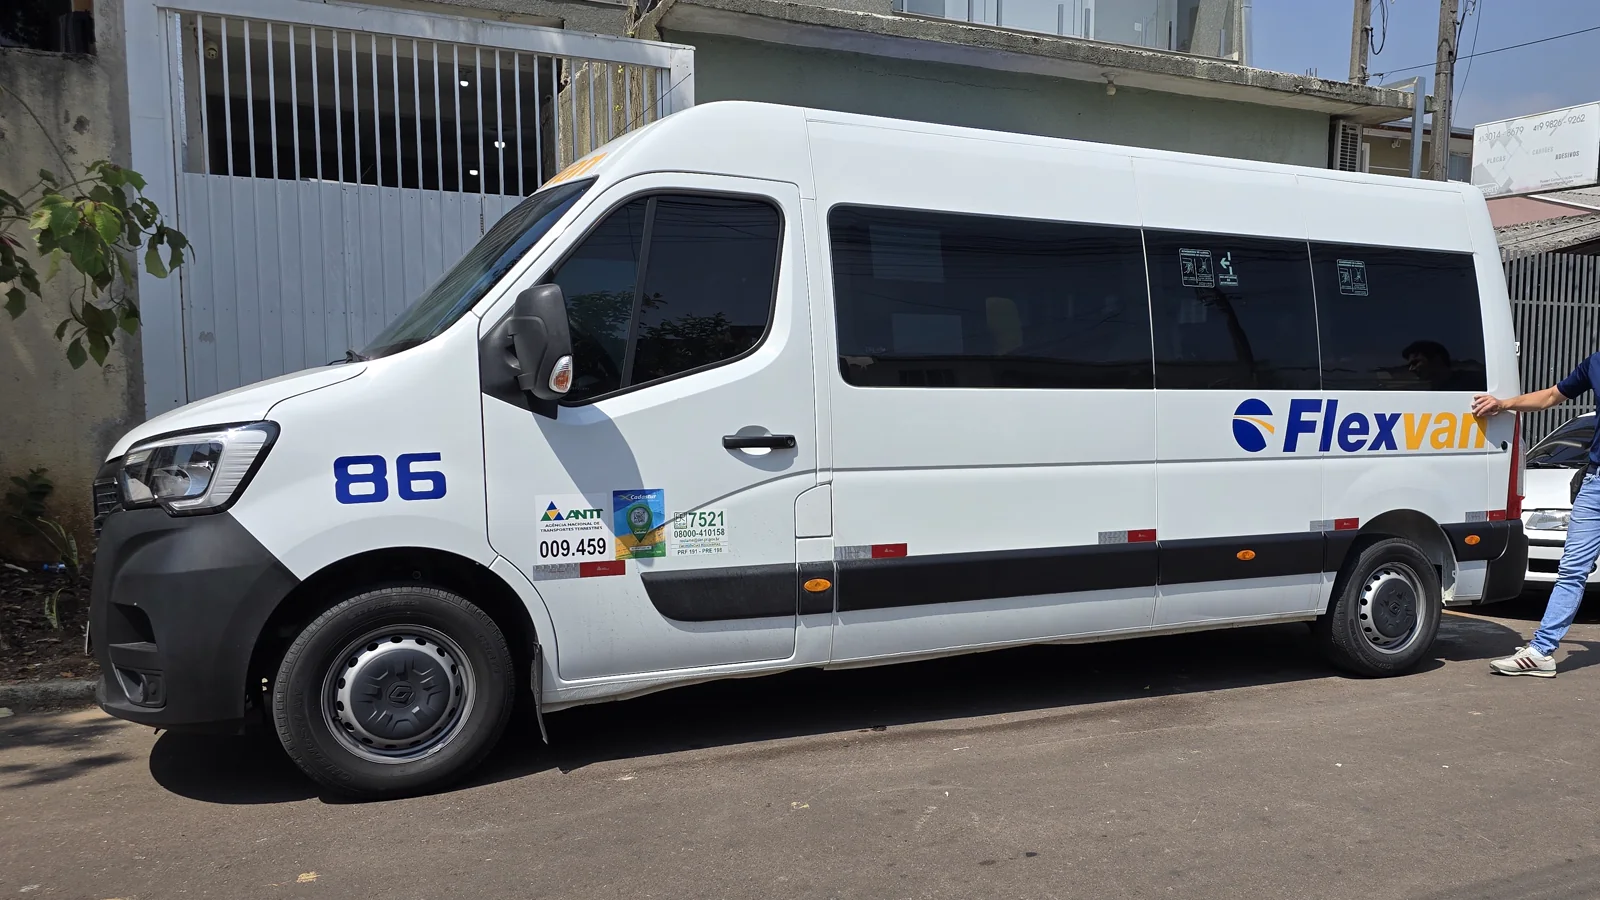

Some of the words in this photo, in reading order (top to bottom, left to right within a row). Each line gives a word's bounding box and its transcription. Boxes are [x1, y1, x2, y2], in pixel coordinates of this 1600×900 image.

[1567, 114, 1585, 125] 9262
[1486, 155, 1506, 165] PLACAS
[1555, 150, 1580, 160] ADESIVOS
[1282, 398, 1488, 453] Flexvan
[333, 452, 447, 505] 86
[565, 508, 604, 520] ANTT
[688, 511, 724, 527] 7521
[674, 528, 725, 538] 08000-410158
[540, 537, 607, 559] 009.459
